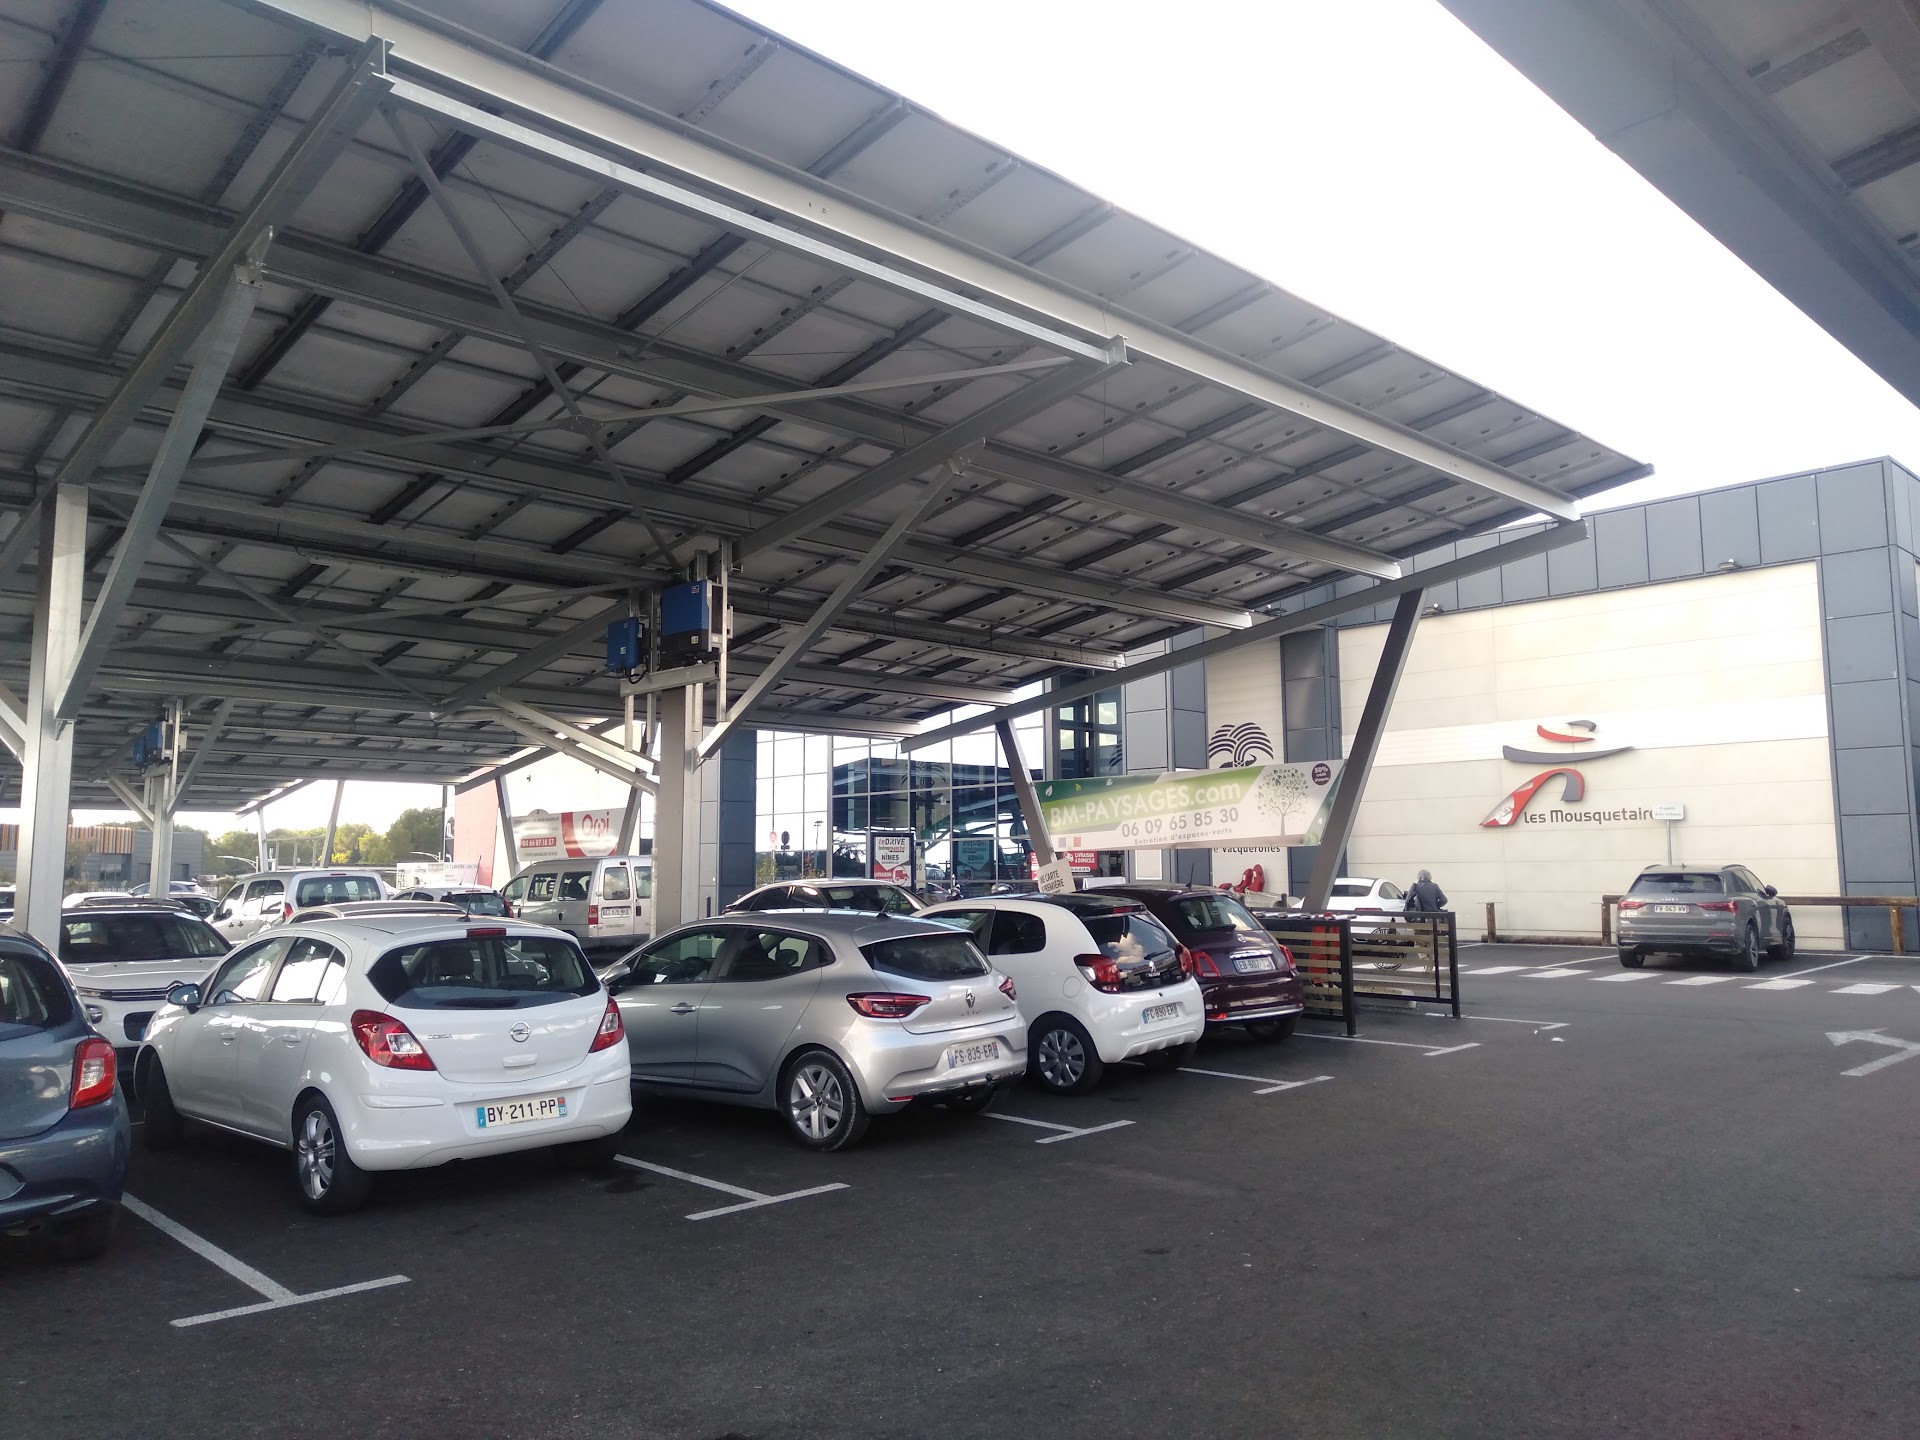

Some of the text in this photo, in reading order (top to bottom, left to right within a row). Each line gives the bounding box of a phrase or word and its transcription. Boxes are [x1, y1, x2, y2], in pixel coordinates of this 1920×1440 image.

[1051, 782, 1241, 828] BM-PAYSAGES.com
[582, 811, 610, 838] Orpi
[1121, 807, 1239, 837] 06 09 65 85 30
[1134, 835, 1168, 846] Entretien
[1045, 869, 1060, 882] CARTE
[954, 1044, 993, 1064] FS-835-ER
[487, 1099, 556, 1123] BY-211-PP
